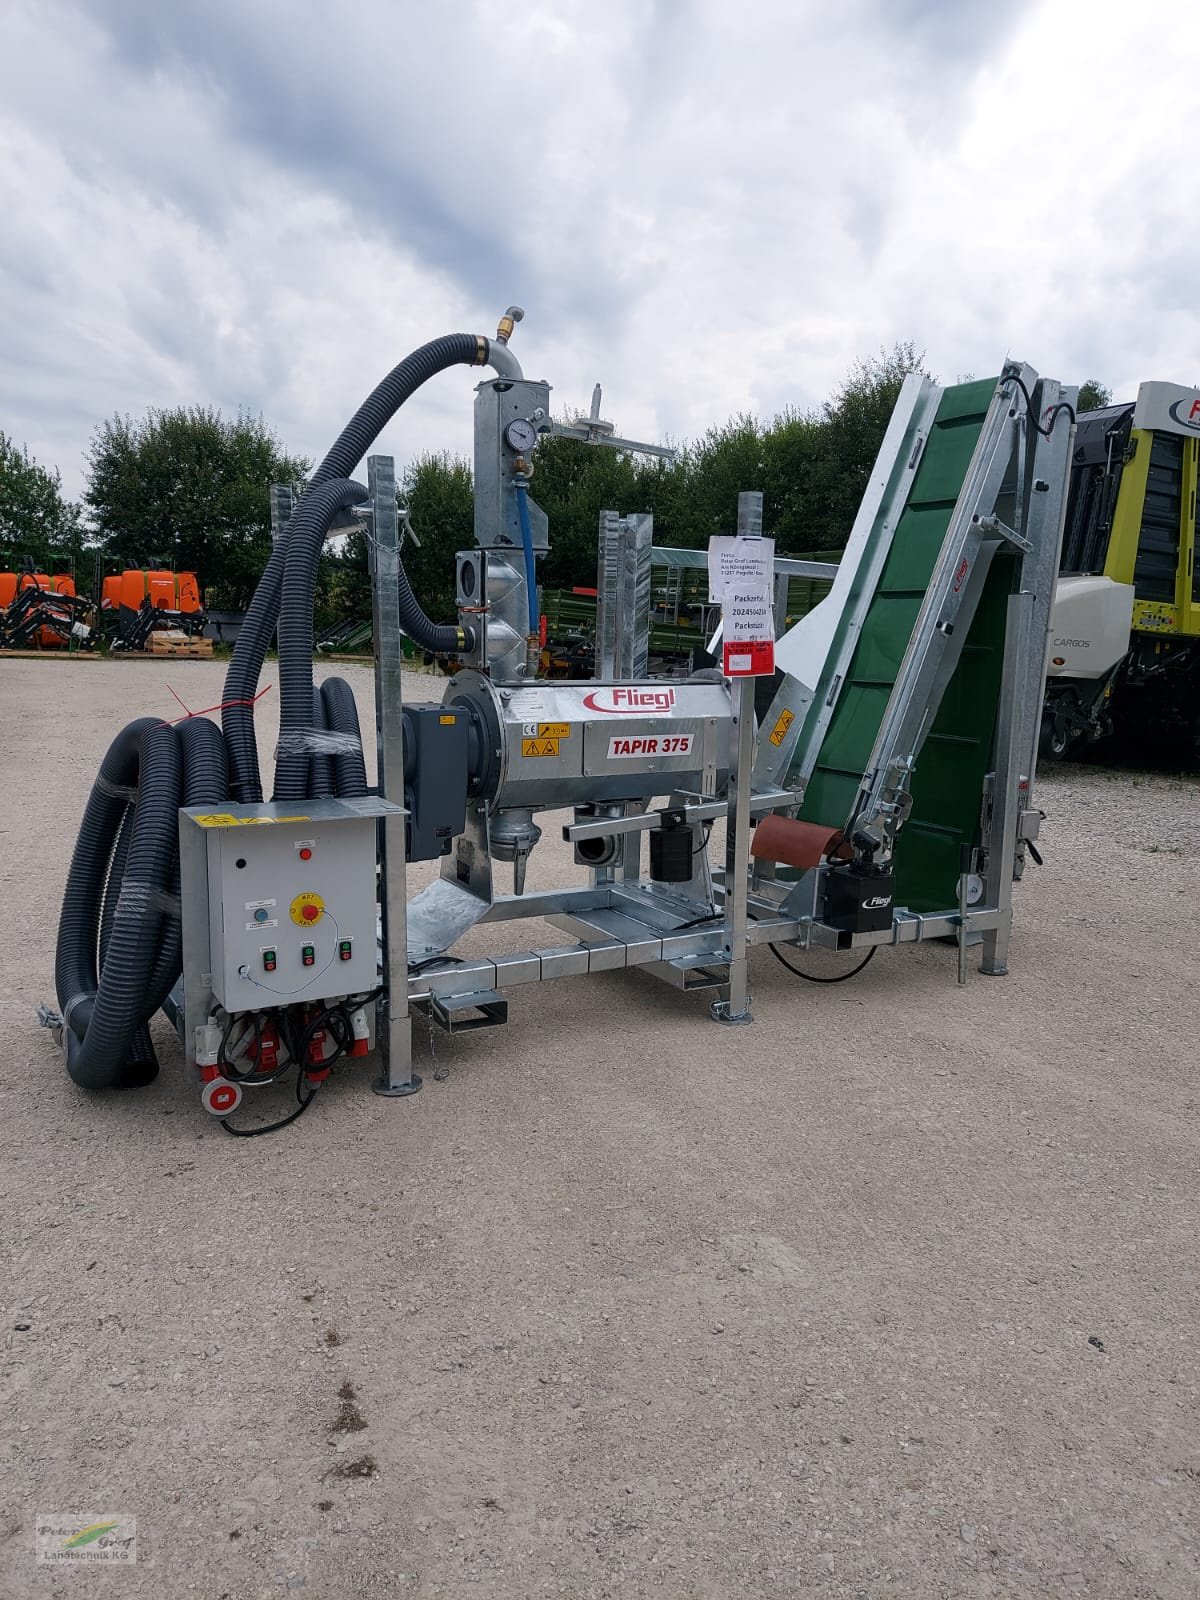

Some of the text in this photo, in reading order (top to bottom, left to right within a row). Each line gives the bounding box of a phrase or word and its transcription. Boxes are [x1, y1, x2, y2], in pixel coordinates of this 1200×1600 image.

[1053, 638, 1092, 648] CARGOS
[612, 688, 675, 709] Fliegl
[613, 737, 690, 755] TAPIR 375
